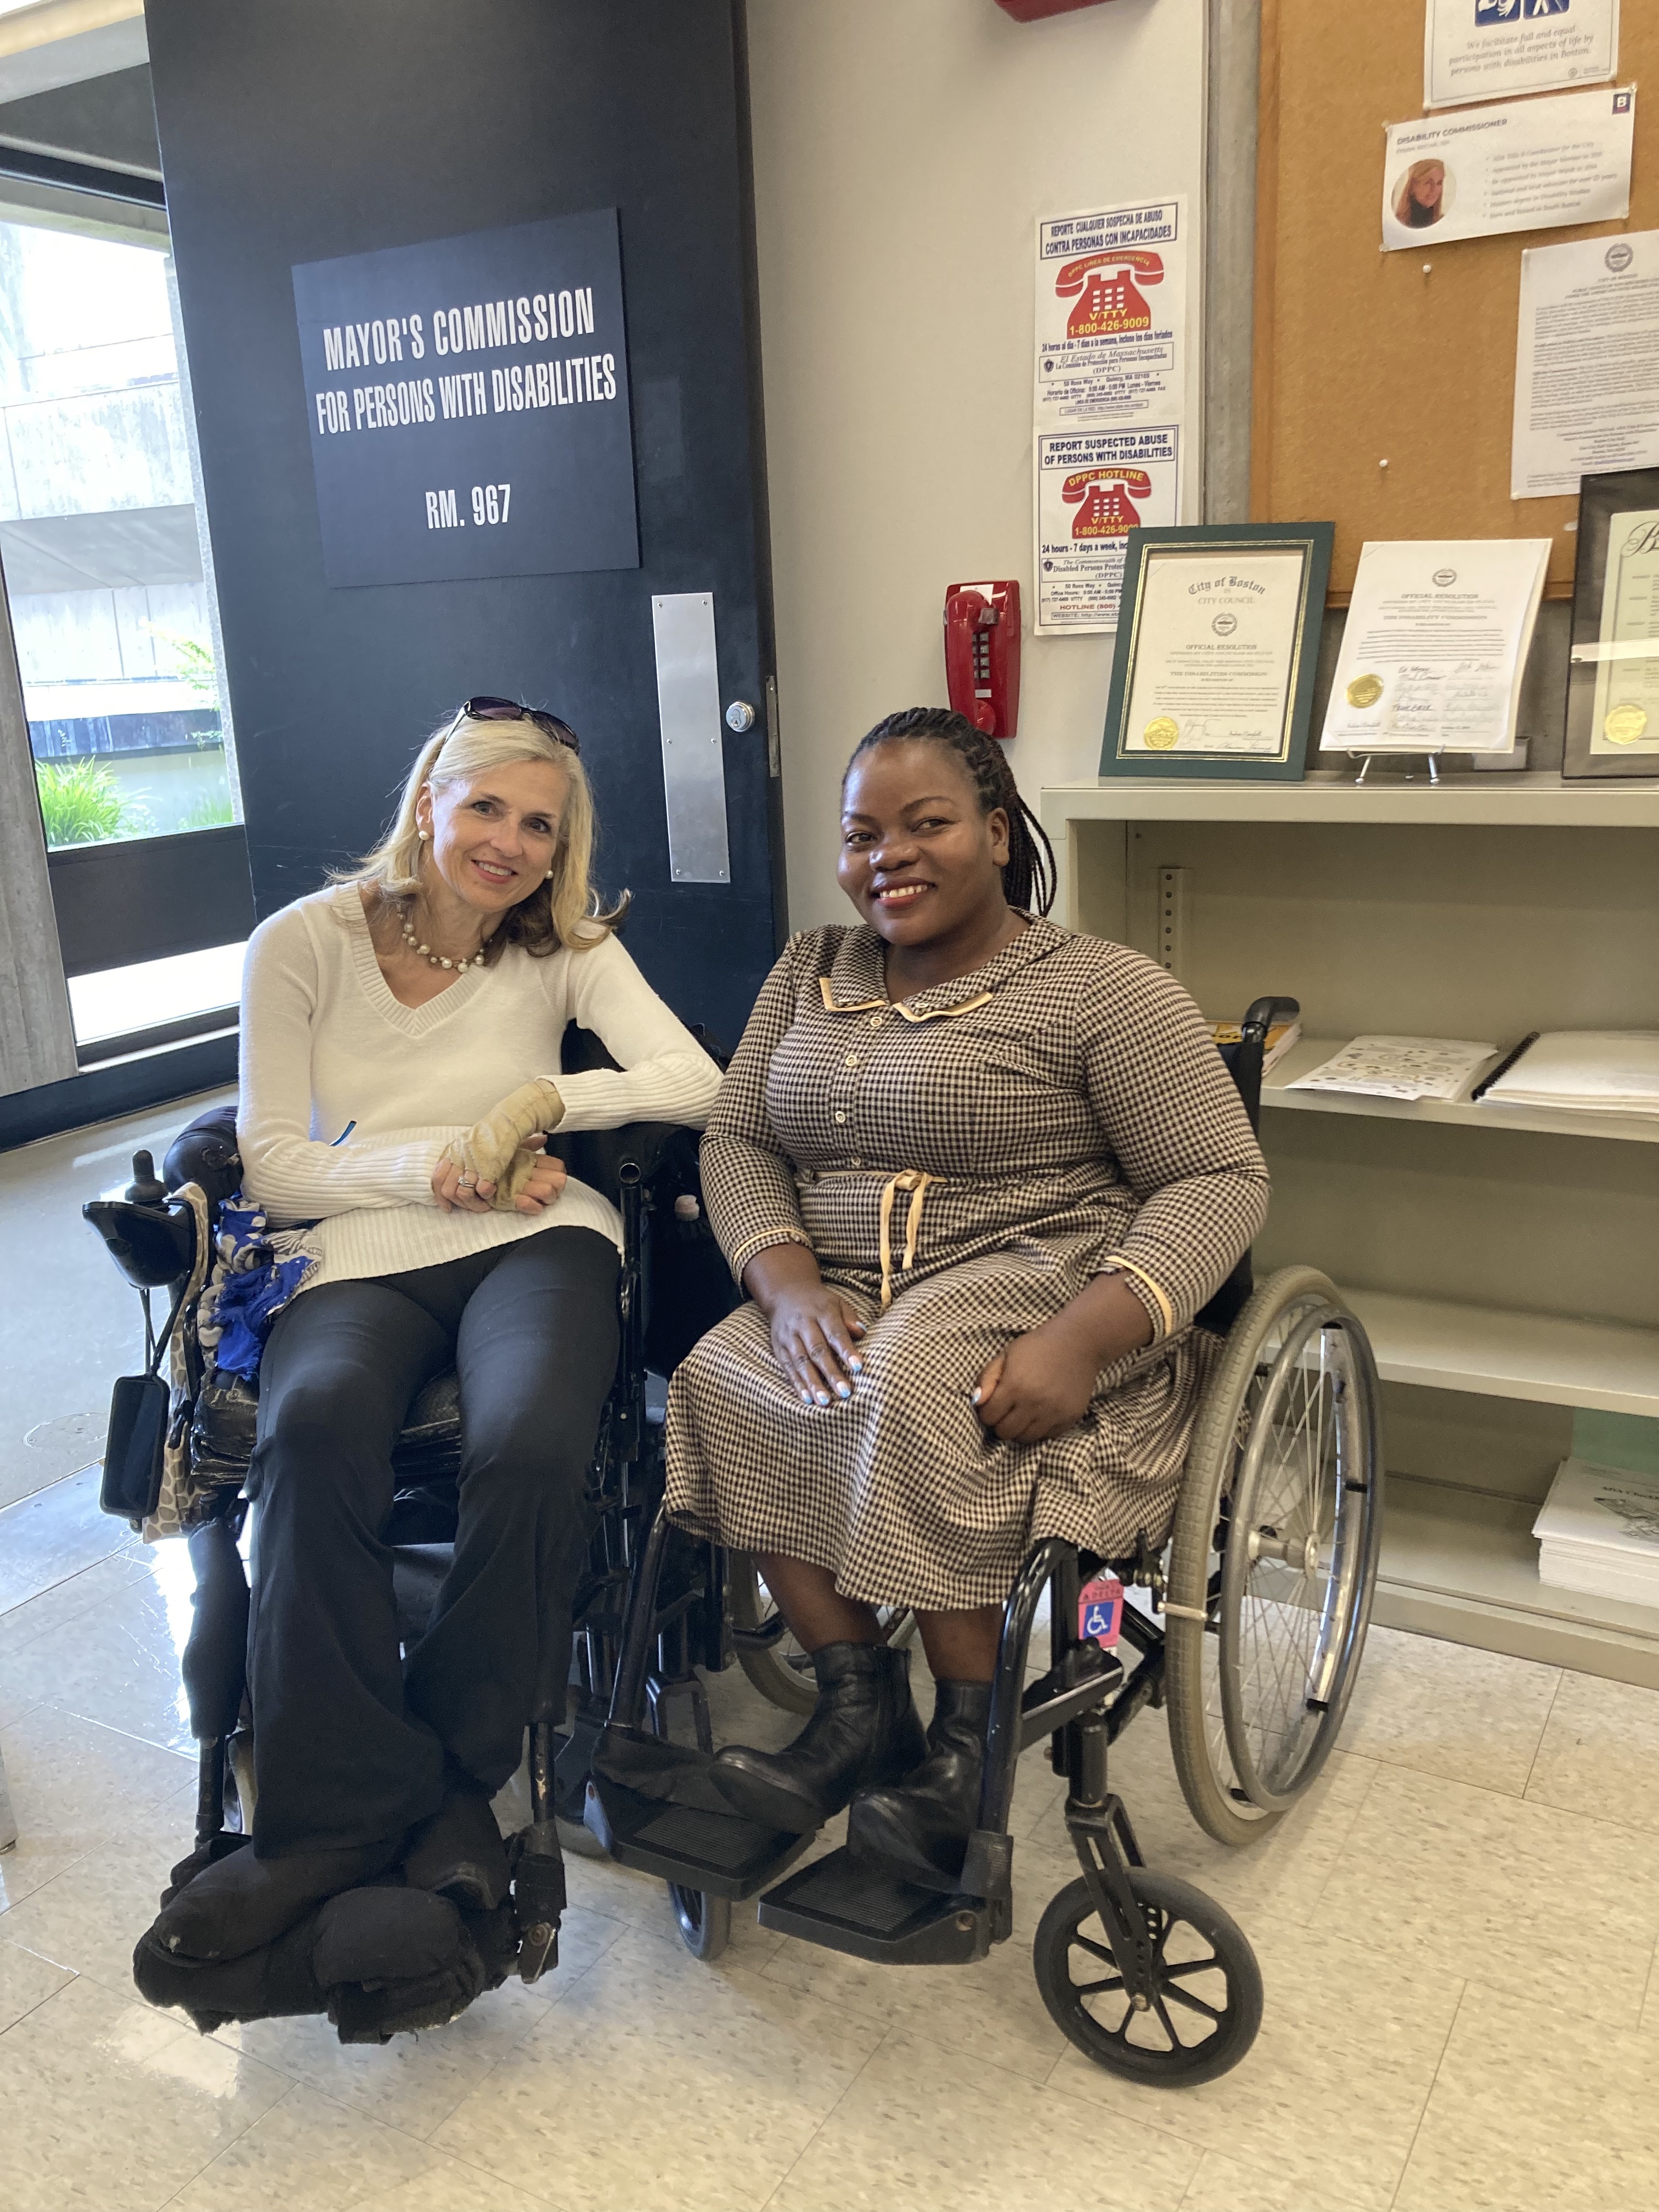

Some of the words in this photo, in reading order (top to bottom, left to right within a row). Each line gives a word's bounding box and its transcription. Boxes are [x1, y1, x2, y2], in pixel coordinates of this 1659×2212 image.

[1616, 96, 1627, 108] B
[1397, 130, 1441, 145] DISABILITY
[1442, 119, 1507, 137] COMMISSIONER
[1051, 223, 1074, 237] REPORTE
[1076, 218, 1105, 233] CUALQUIER
[1106, 213, 1133, 229] SOSPECHA
[1136, 212, 1142, 224] DE
[1144, 210, 1163, 223] ABUSO
[1046, 239, 1070, 255] CONTRA
[1071, 235, 1103, 251] PERSONAS
[1105, 232, 1118, 245] CON
[1120, 225, 1171, 244] INCAPACIDADES
[1088, 308, 1128, 320] V/TTY
[323, 314, 425, 371] MAYOR'S
[433, 287, 595, 356] COMMISSION
[1070, 317, 1149, 336] 1-800-426-9009
[1042, 343, 1047, 352] 24
[1048, 342, 1060, 352] horas
[1071, 353, 1095, 362] Estado
[1097, 352, 1106, 360] de
[1108, 347, 1163, 358] Massachusetts
[316, 391, 351, 435] FOR
[353, 378, 436, 430] PERSONS
[438, 371, 487, 419] WITH
[491, 353, 617, 413] DISABILITIES
[1049, 440, 1082, 452] REPORT
[1085, 437, 1136, 450] SUSPECTED
[1138, 433, 1167, 445] ABUSE
[1045, 454, 1055, 465] OF
[1057, 452, 1094, 464] PERSONS
[1096, 450, 1117, 461] WITH
[1119, 447, 1172, 460] DISABILITIES
[1069, 472, 1096, 487] DPPC
[1098, 470, 1143, 482] HOTLINE
[425, 489, 465, 529] RM.
[471, 483, 511, 526] 967
[1091, 516, 1124, 524] V/TTY
[1042, 544, 1050, 554] 24
[1051, 544, 1069, 553] hours
[1074, 543, 1077, 552] 7
[1079, 543, 1093, 554] days
[1101, 541, 1117, 551] week,
[1188, 582, 1211, 595] City
[1215, 576, 1227, 587] of
[1229, 576, 1266, 595] Boston
